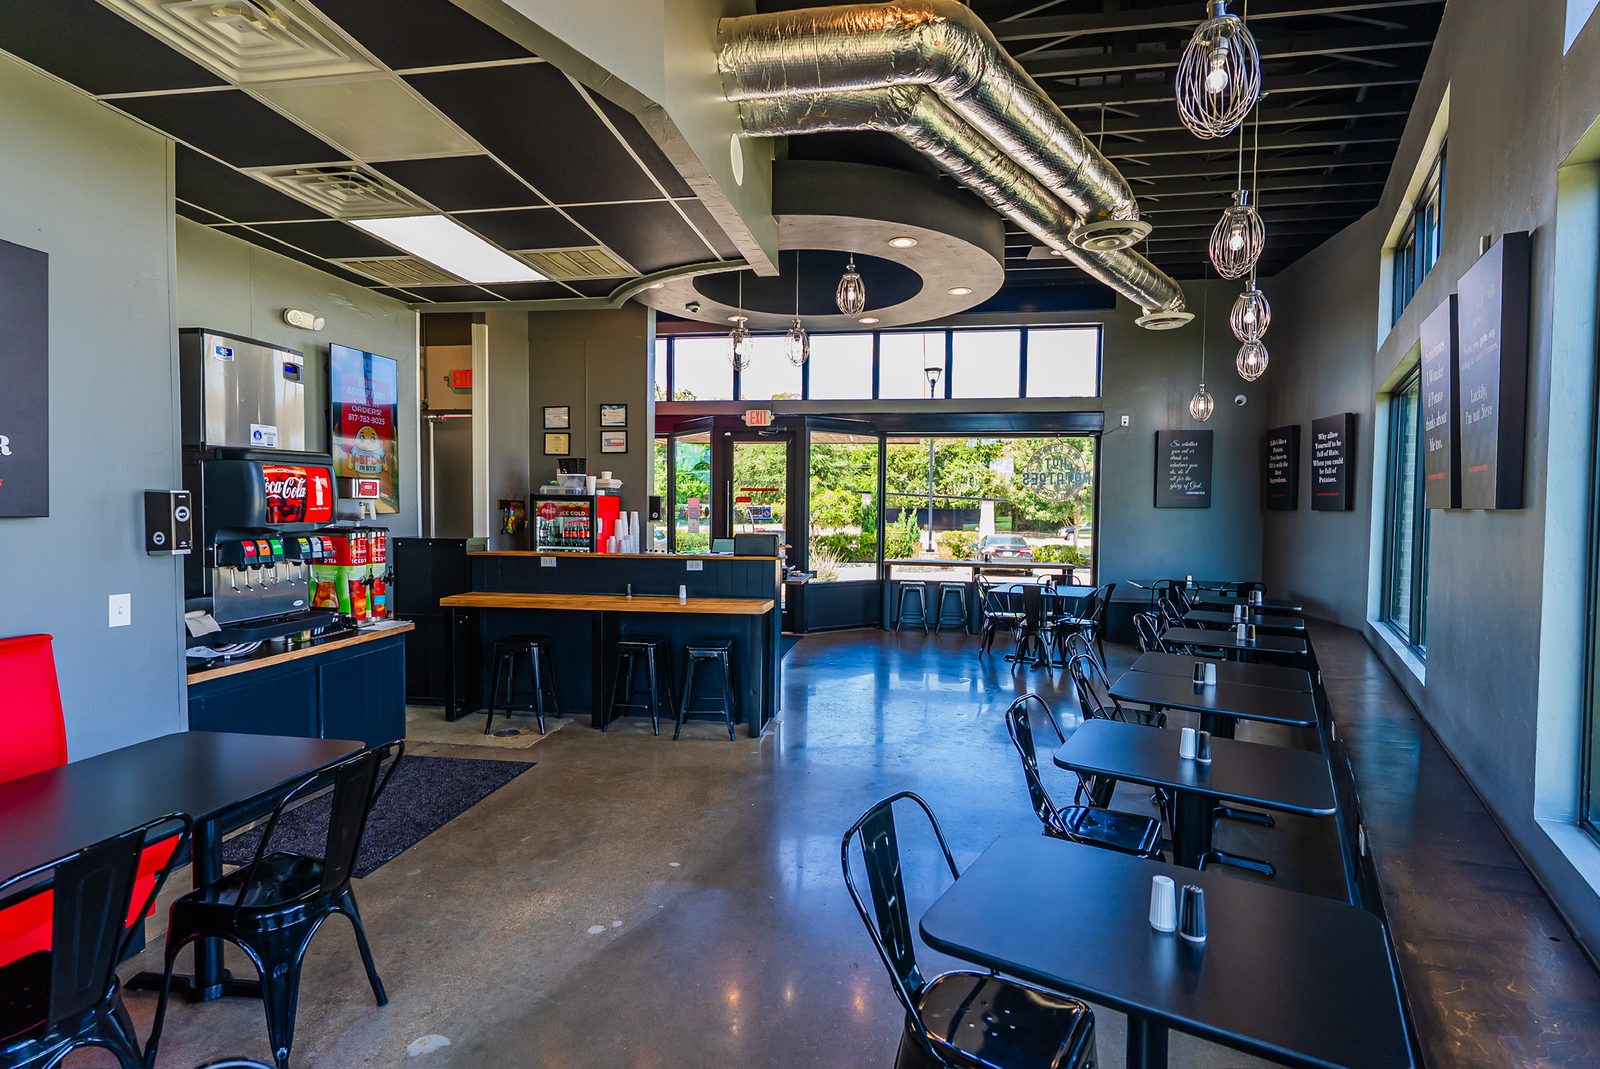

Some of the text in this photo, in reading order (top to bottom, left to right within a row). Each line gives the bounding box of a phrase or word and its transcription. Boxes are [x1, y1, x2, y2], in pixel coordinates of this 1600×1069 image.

[750, 410, 767, 425] EXIT
[1481, 404, 1493, 419] Steve
[348, 413, 385, 425] 817-782-9025
[1436, 410, 1447, 427] about
[1315, 441, 1332, 449] Yourself
[1313, 459, 1324, 467] When
[1332, 457, 1344, 465] could
